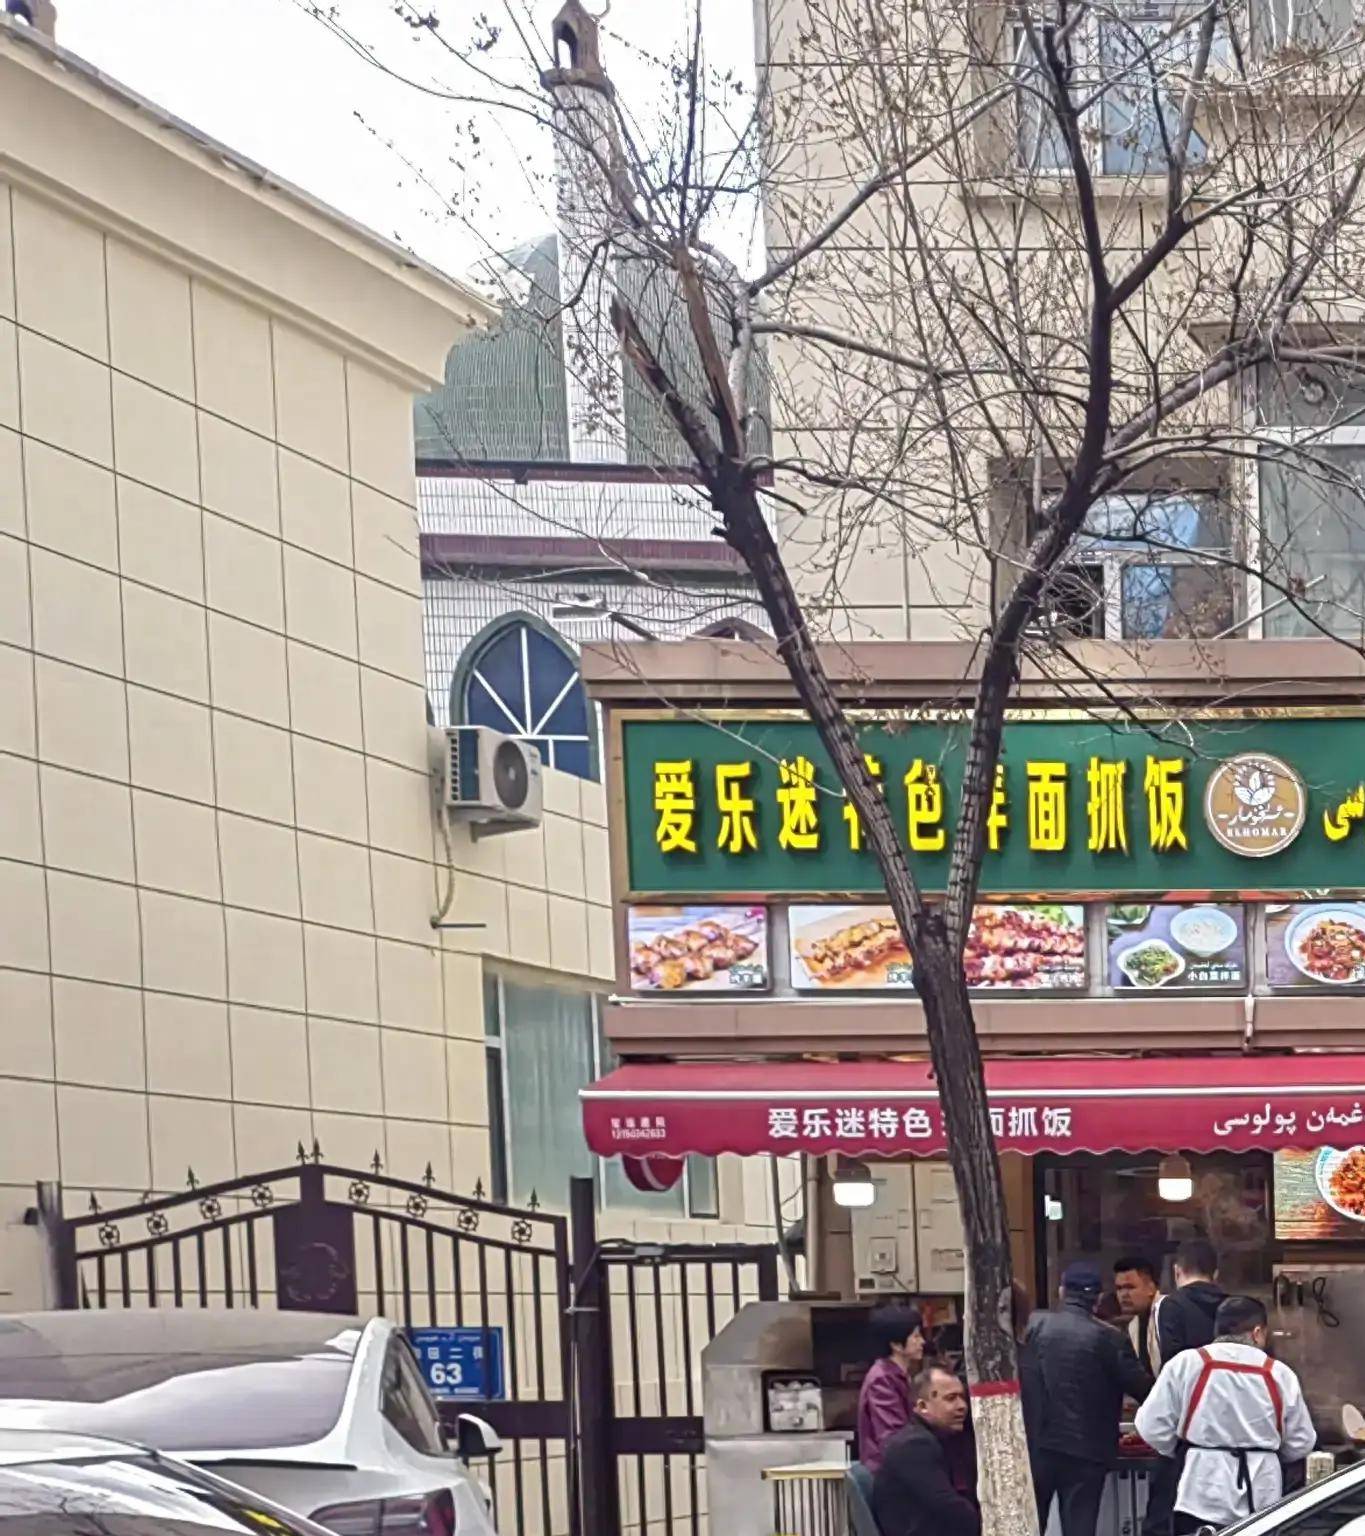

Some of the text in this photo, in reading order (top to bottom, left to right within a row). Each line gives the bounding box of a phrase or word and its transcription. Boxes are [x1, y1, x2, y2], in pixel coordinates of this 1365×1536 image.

[653, 756, 1190, 853] 爱乐迷色面抓饭
[768, 1107, 1073, 1139] 爱乐迷特色面抓饭
[430, 1362, 462, 1384] 63
